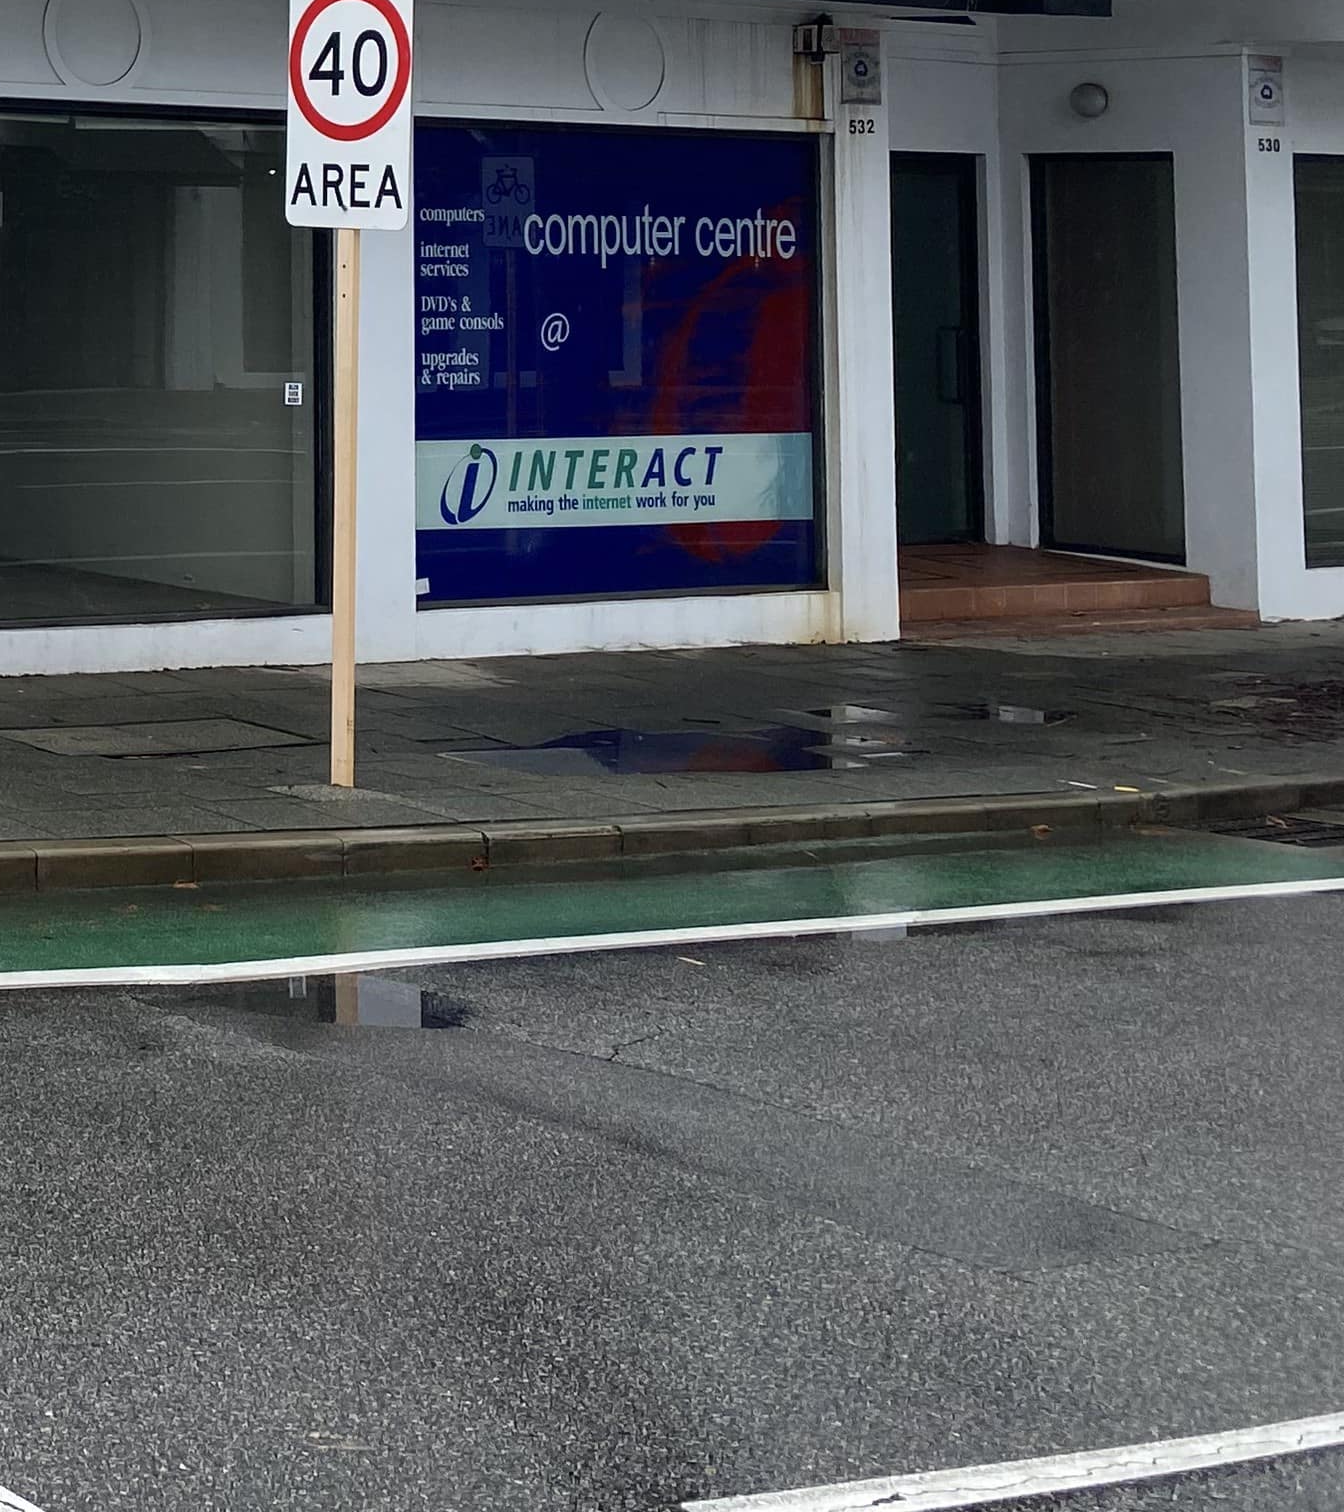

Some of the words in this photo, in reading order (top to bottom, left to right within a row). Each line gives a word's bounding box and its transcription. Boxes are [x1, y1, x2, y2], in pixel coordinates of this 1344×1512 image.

[308, 28, 389, 98] 40
[848, 119, 876, 134] 532
[1257, 137, 1281, 153] 530
[289, 161, 403, 211] AREA
[419, 207, 486, 227] computers
[522, 203, 687, 269] computer
[694, 208, 797, 260] centre
[419, 240, 470, 258] internet
[419, 260, 470, 277] services
[421, 295, 458, 312] DVD's
[460, 295, 472, 312] &
[421, 316, 456, 335] game
[459, 312, 505, 330] consols
[421, 347, 480, 372] upgrades
[421, 368, 432, 385] &
[436, 368, 481, 390] repairs
[508, 445, 724, 492] INTERACT
[507, 494, 555, 515] making
[558, 493, 579, 511] the
[582, 493, 632, 510] internet
[635, 491, 667, 509] work
[671, 491, 690, 508] for
[693, 493, 716, 512] you
